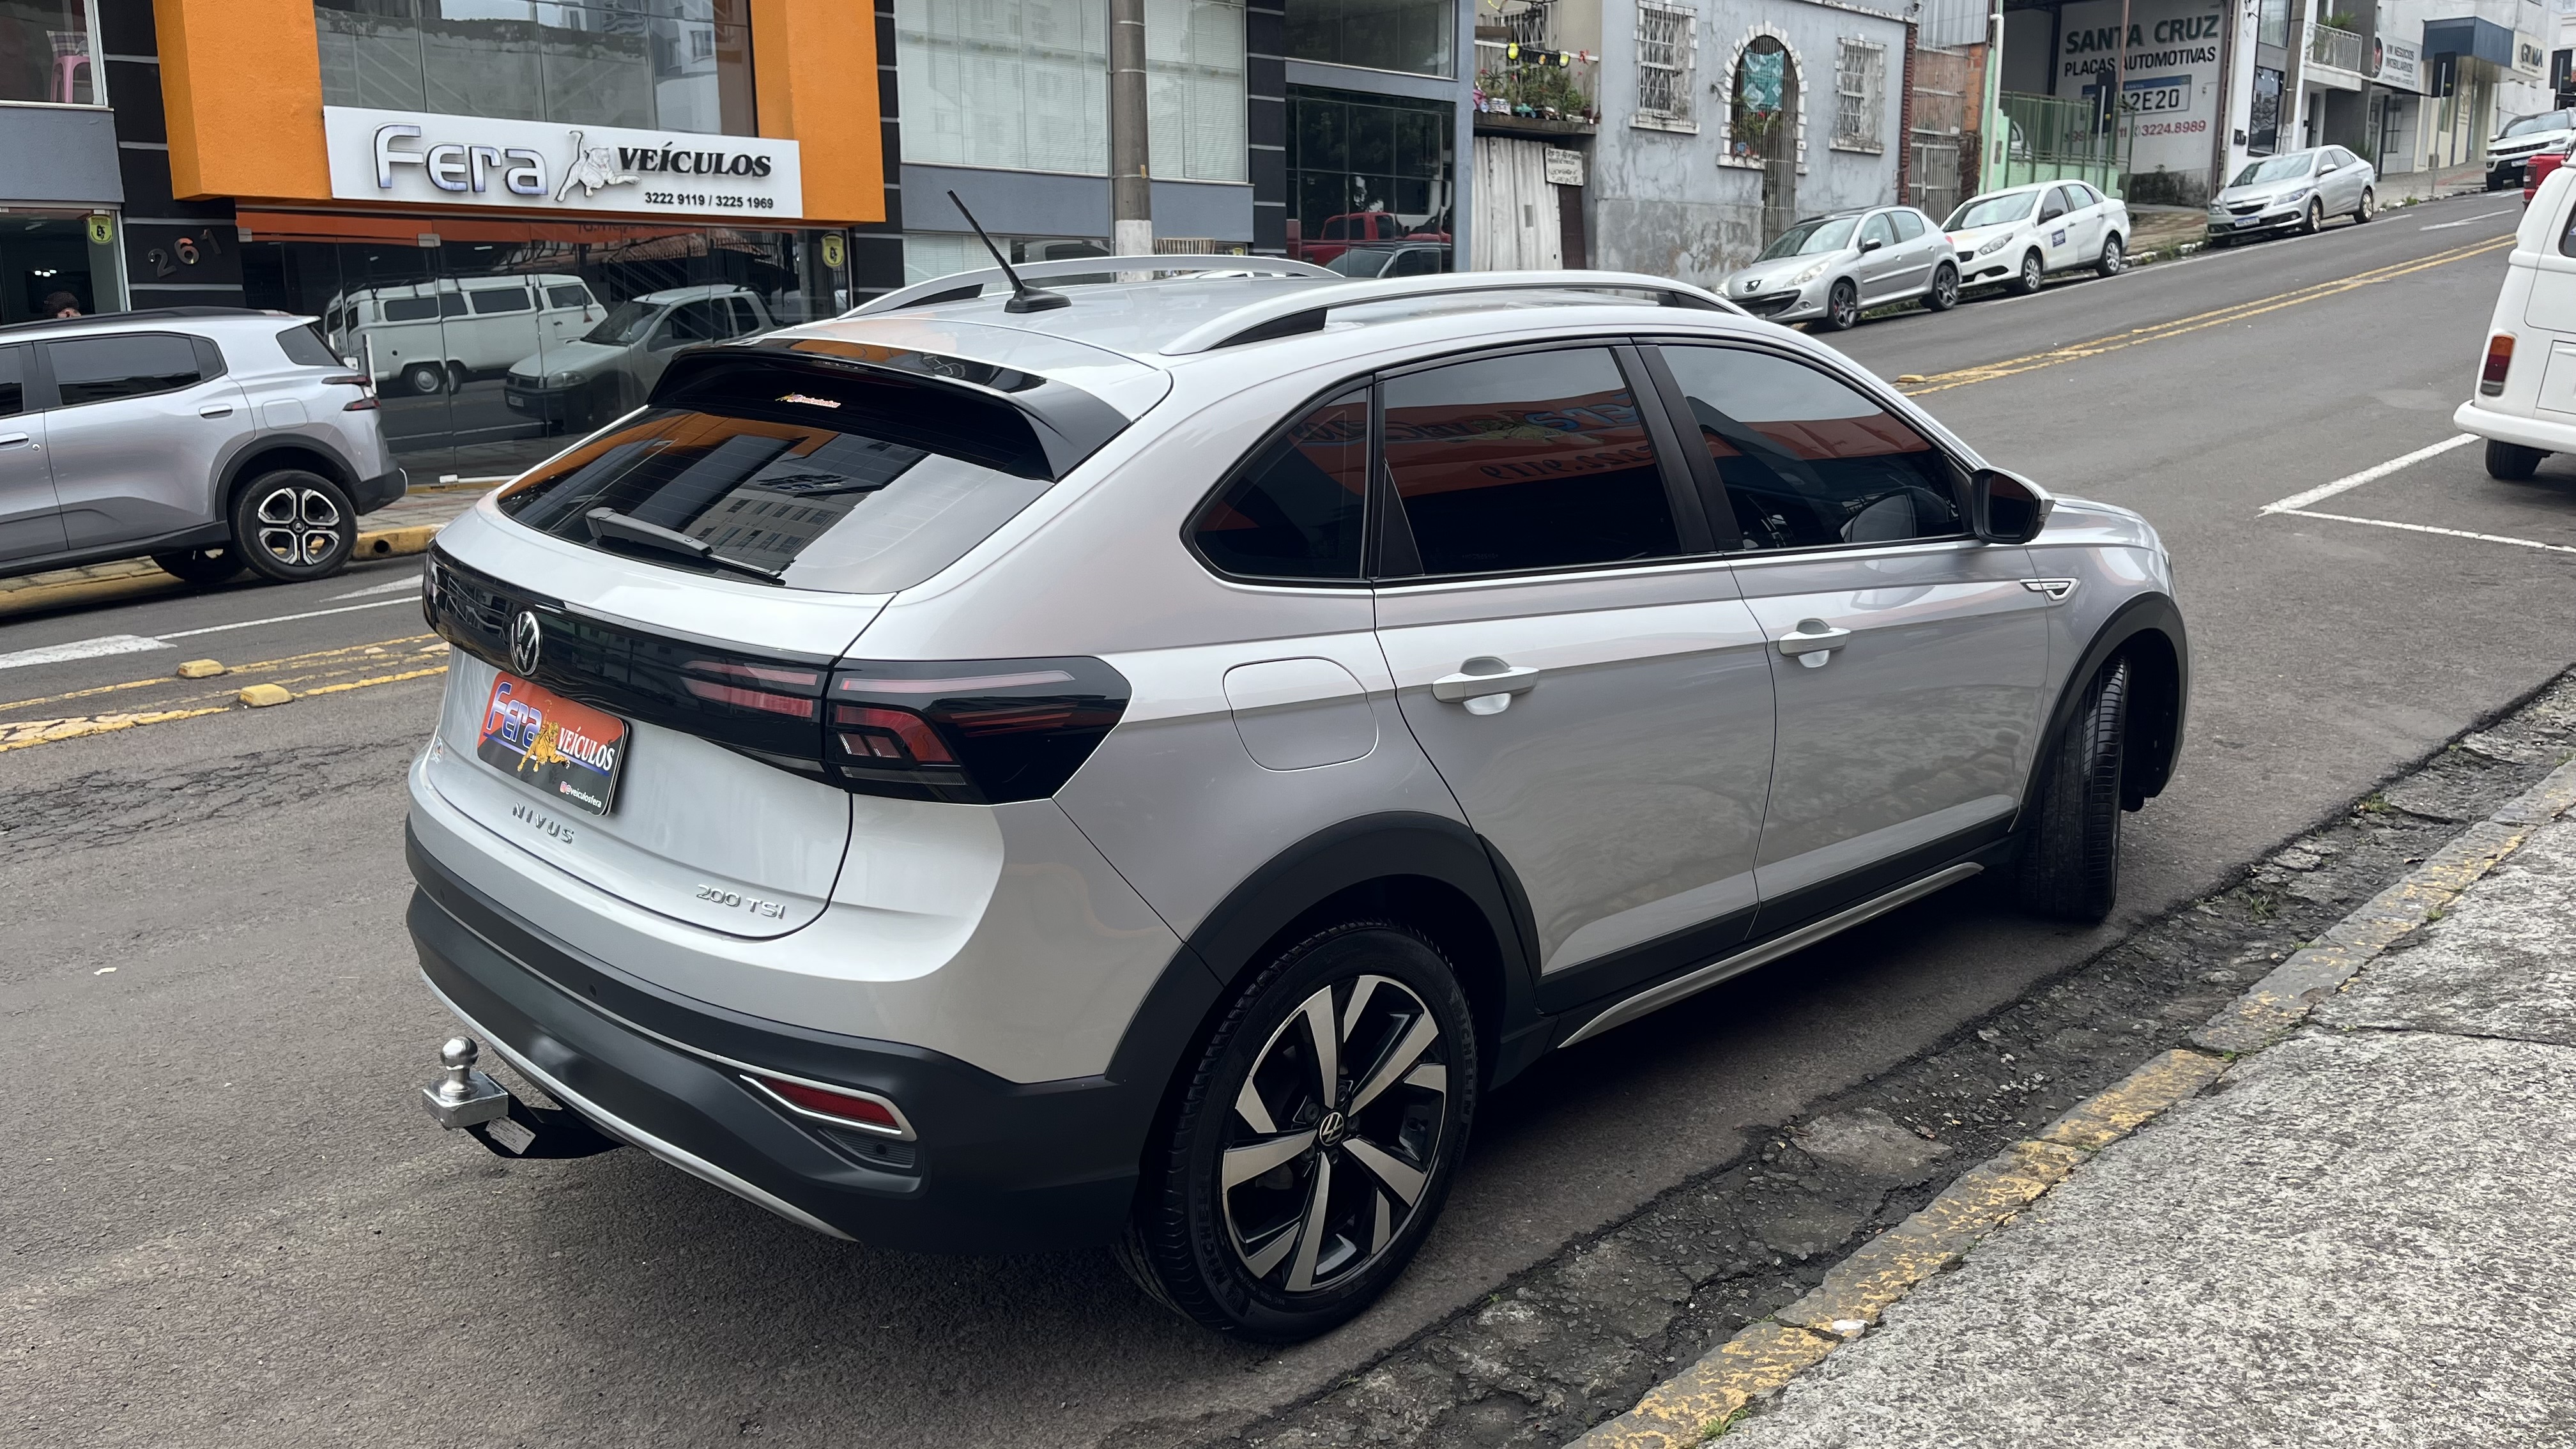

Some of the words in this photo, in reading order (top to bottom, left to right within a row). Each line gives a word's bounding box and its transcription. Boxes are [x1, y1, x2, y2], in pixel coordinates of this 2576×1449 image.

[2066, 24, 2145, 55] SANTA
[2154, 14, 2220, 43] CRUZ
[2064, 57, 2116, 77] PLACAS
[2141, 120, 2207, 137] 3224.8989
[374, 123, 548, 195] Fera
[618, 141, 772, 178] VEÍCULOS
[645, 192, 674, 204] 3222
[677, 193, 705, 206] 9119
[716, 195, 743, 208] 3225
[747, 197, 774, 209] 1969
[148, 227, 222, 277] 261
[558, 726, 615, 770] VEÍCULOS
[565, 784, 602, 808] @veiculosfera
[512, 802, 574, 844] NIVUS
[696, 884, 740, 907] 200
[746, 896, 786, 919] TSI
